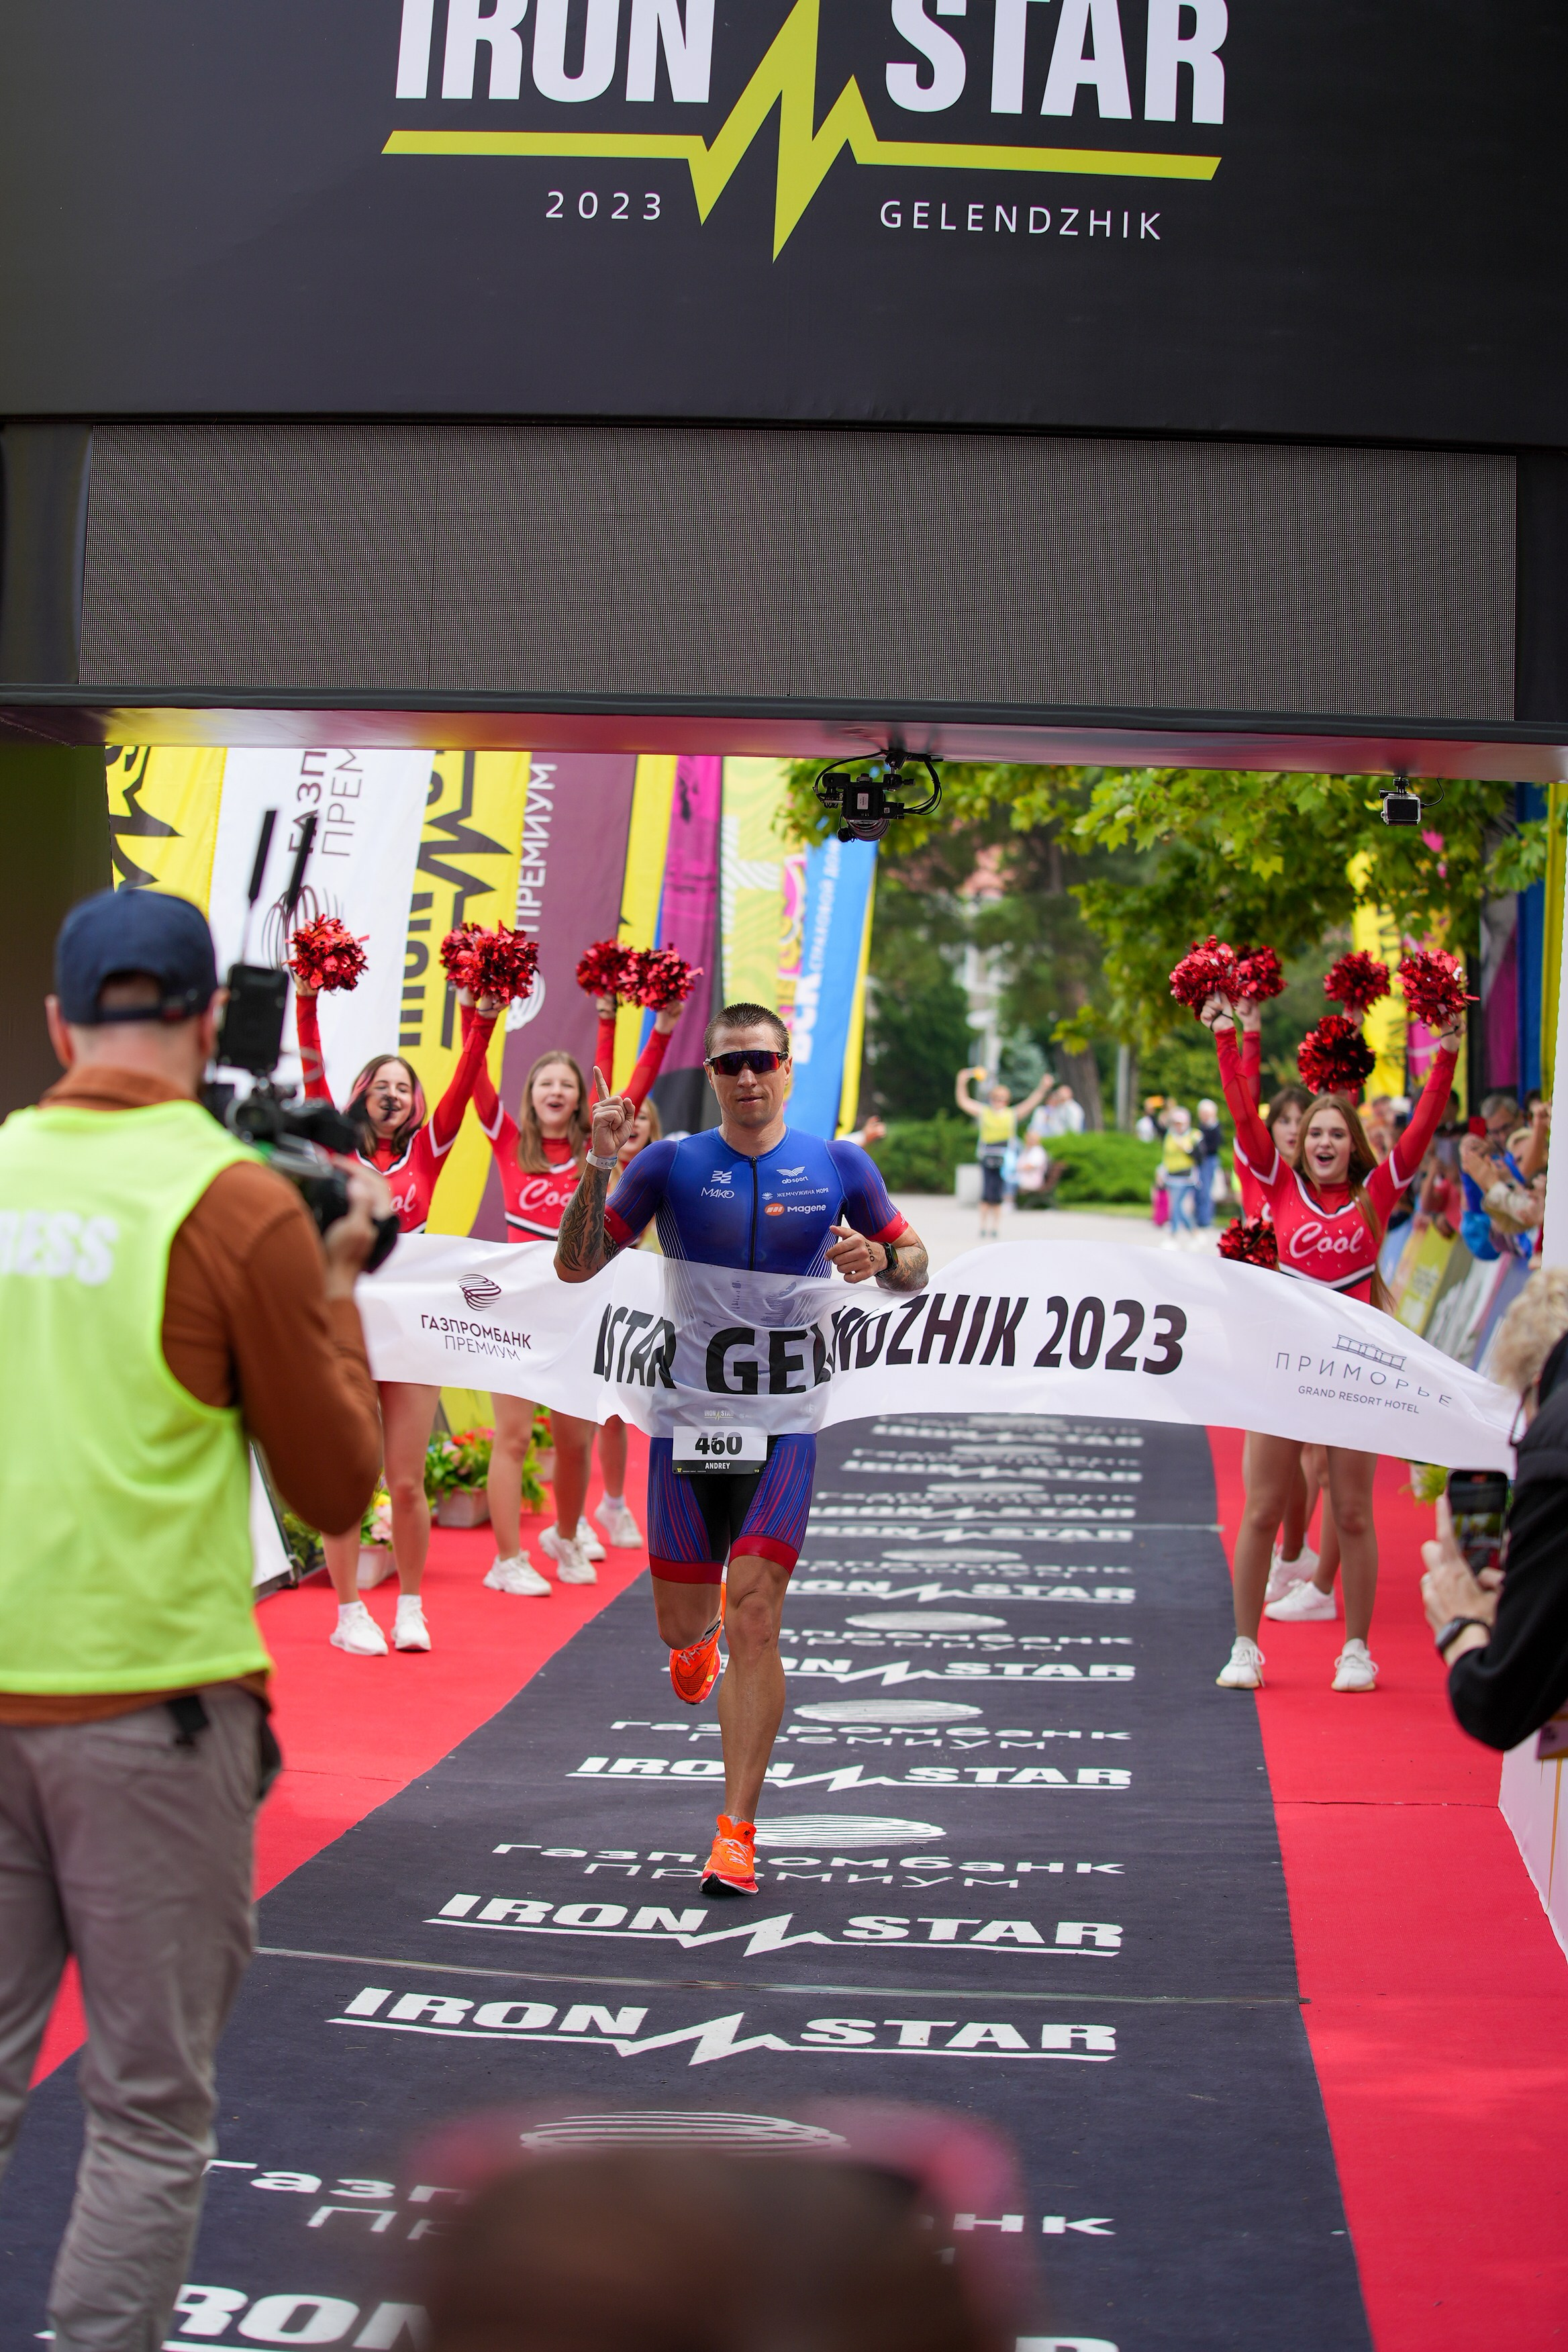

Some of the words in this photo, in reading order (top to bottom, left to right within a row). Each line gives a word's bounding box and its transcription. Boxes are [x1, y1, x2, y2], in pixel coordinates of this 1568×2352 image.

[393, 0, 712, 103] IRON
[886, 0, 1229, 124] STAR
[545, 191, 663, 221] 2023
[879, 199, 1163, 241] GELENDZHIK
[514, 763, 558, 932] ПРЕМИУМ
[777, 1189, 815, 1197] ЖЕМЧУЖИНА
[787, 1204, 826, 1214] Magene
[1289, 1221, 1364, 1259] Cool
[421, 1314, 532, 1349] ГАЗПРОМБАНК
[445, 1335, 521, 1361] ПРЕМИУМ
[1032, 1295, 1187, 1375] 2023
[1275, 1352, 1453, 1408] ПРИМОРЬЕ
[1298, 1385, 1336, 1398] GRAND
[1338, 1391, 1383, 1406] RESORT
[1385, 1399, 1420, 1414] HOTEL
[695, 1432, 742, 1455] 460
[944, 1662, 1136, 1677] STAR
[905, 1767, 1132, 1785] STAR
[437, 1893, 708, 1932] IRON
[842, 1915, 1124, 1947] STAR
[344, 1987, 650, 2035] IRON
[799, 2018, 1117, 2051] STAR
